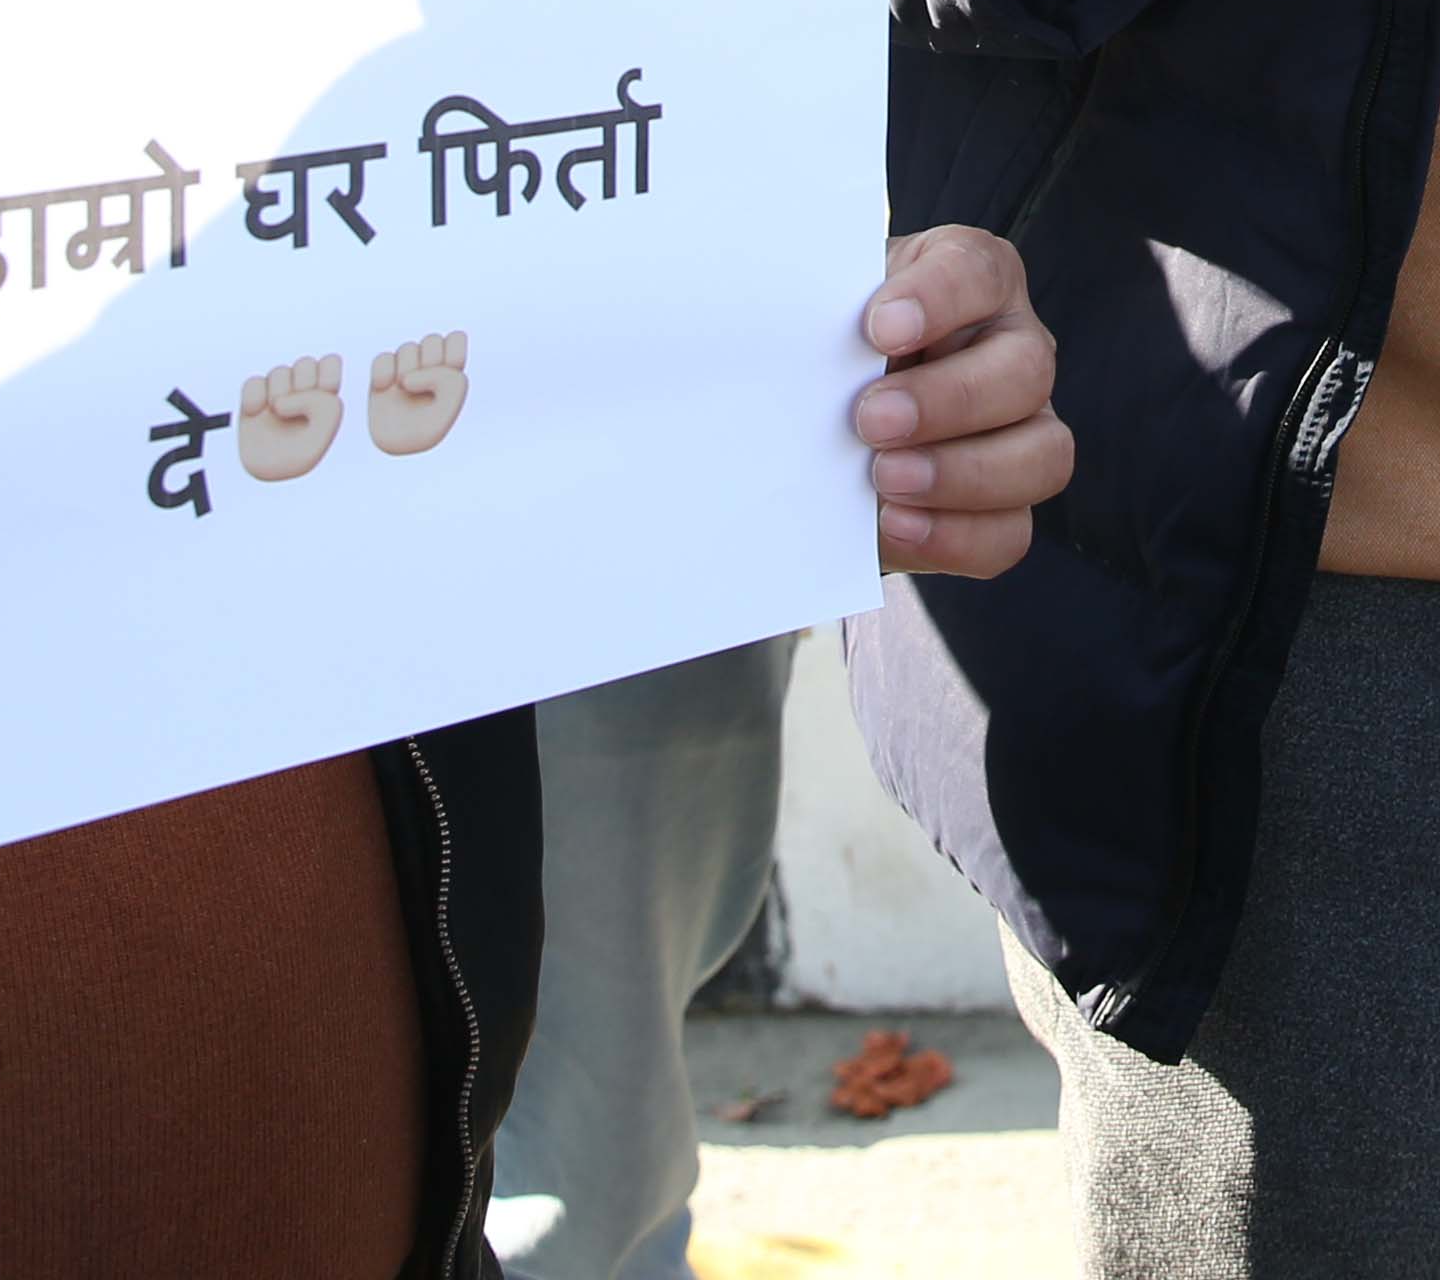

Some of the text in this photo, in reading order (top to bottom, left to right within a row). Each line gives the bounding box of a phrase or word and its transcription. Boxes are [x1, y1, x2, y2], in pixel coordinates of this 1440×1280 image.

[236, 142, 387, 250] घर
[418, 68, 663, 228] फिर्ता
[147, 388, 232, 517] दे
